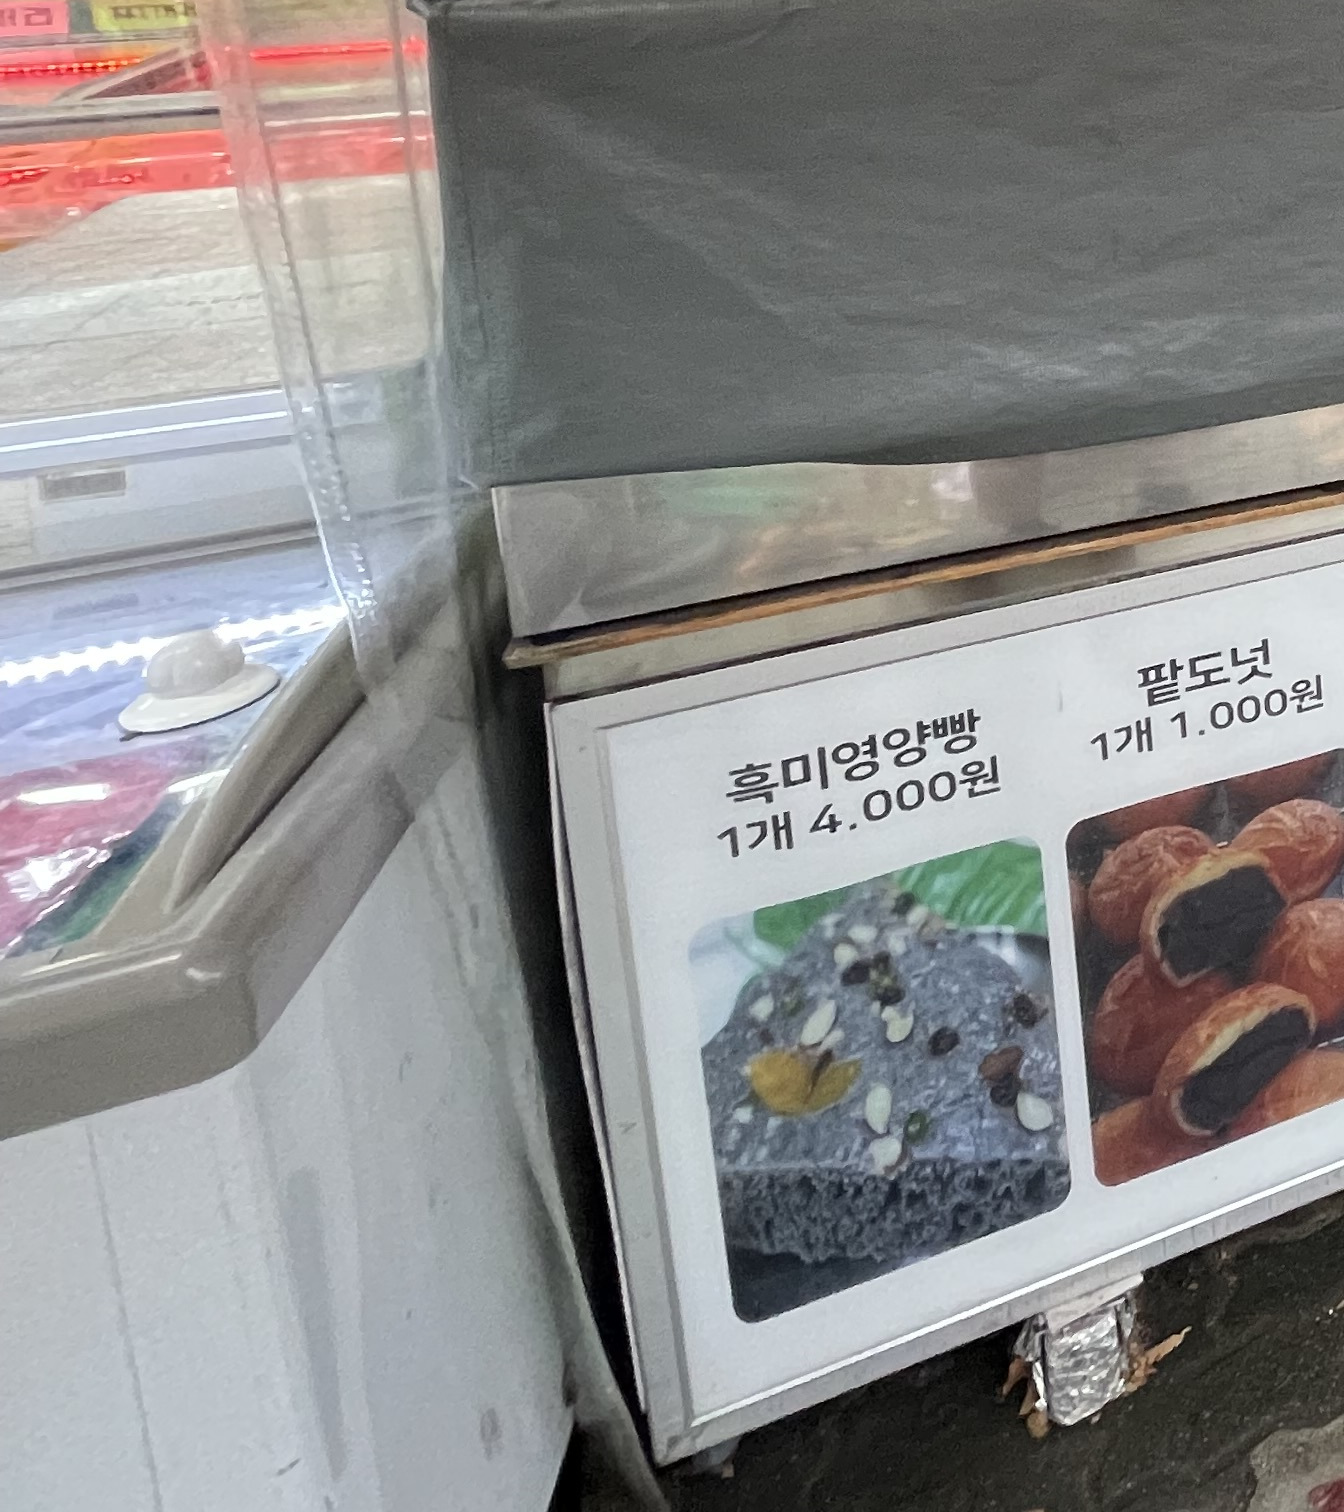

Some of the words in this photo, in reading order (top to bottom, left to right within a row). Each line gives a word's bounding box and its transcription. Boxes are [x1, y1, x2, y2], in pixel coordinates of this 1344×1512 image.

[1090, 715, 1155, 762] 1개
[1170, 674, 1325, 740] 1.000원
[1137, 638, 1274, 708] 팥도넛
[725, 708, 982, 805] 흑미영양빵
[717, 811, 794, 859] 1개
[808, 754, 1002, 836] 4.000원
